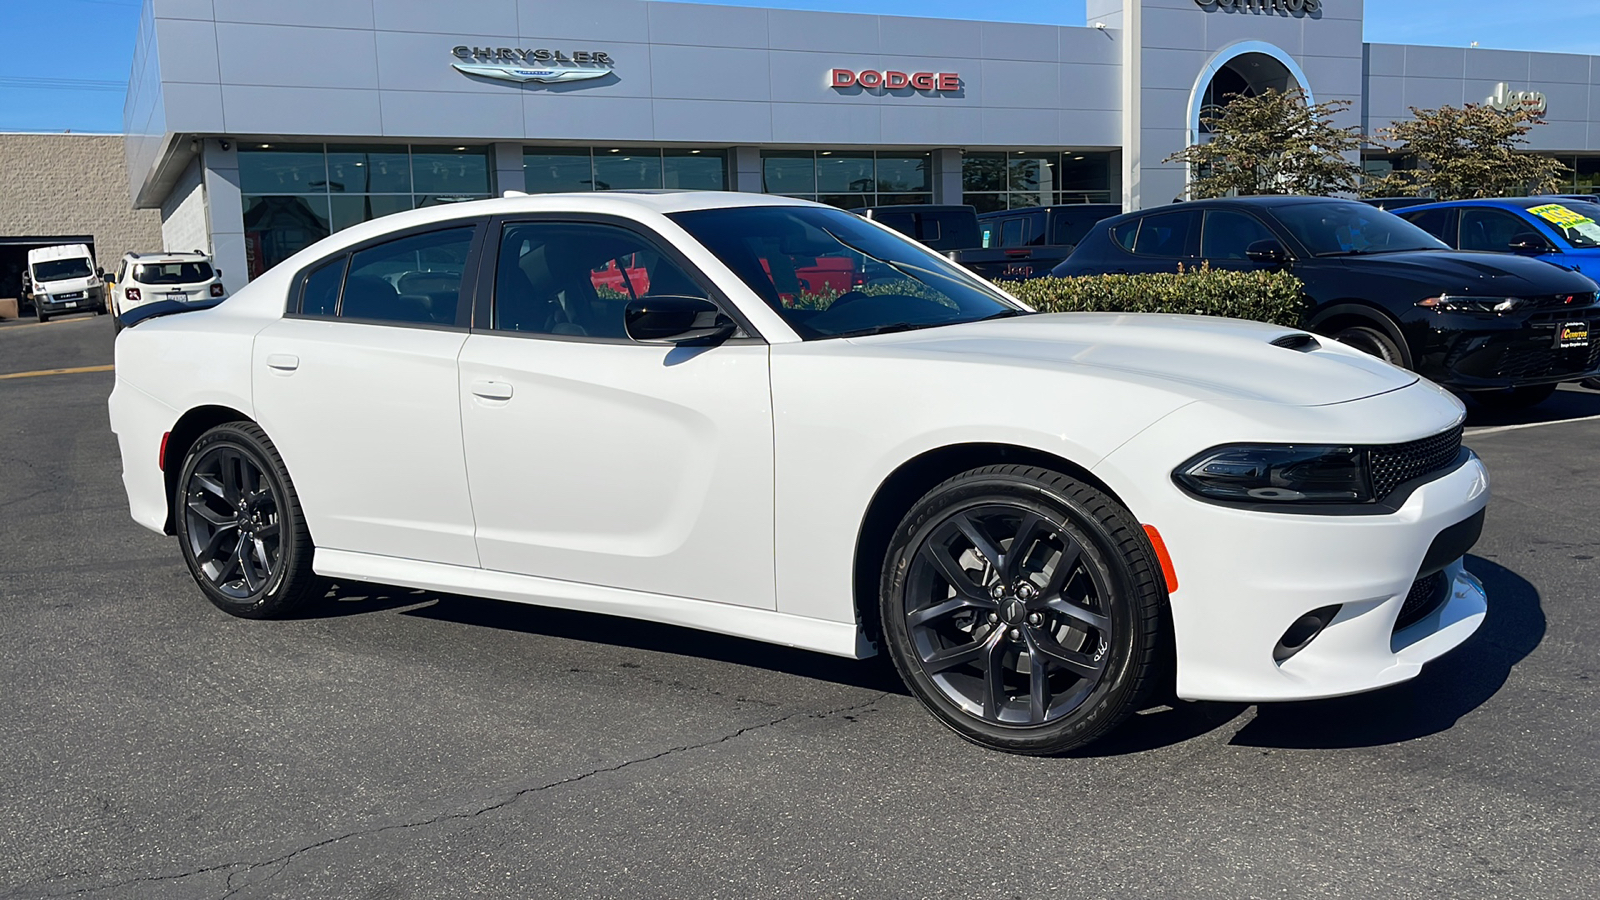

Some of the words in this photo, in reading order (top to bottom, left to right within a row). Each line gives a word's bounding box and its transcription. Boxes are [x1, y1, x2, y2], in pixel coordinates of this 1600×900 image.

[452, 45, 609, 63] CHRYSLER
[831, 68, 960, 91] DODGE
[1488, 82, 1547, 115] Jeep
[1003, 264, 1033, 278] Jeep
